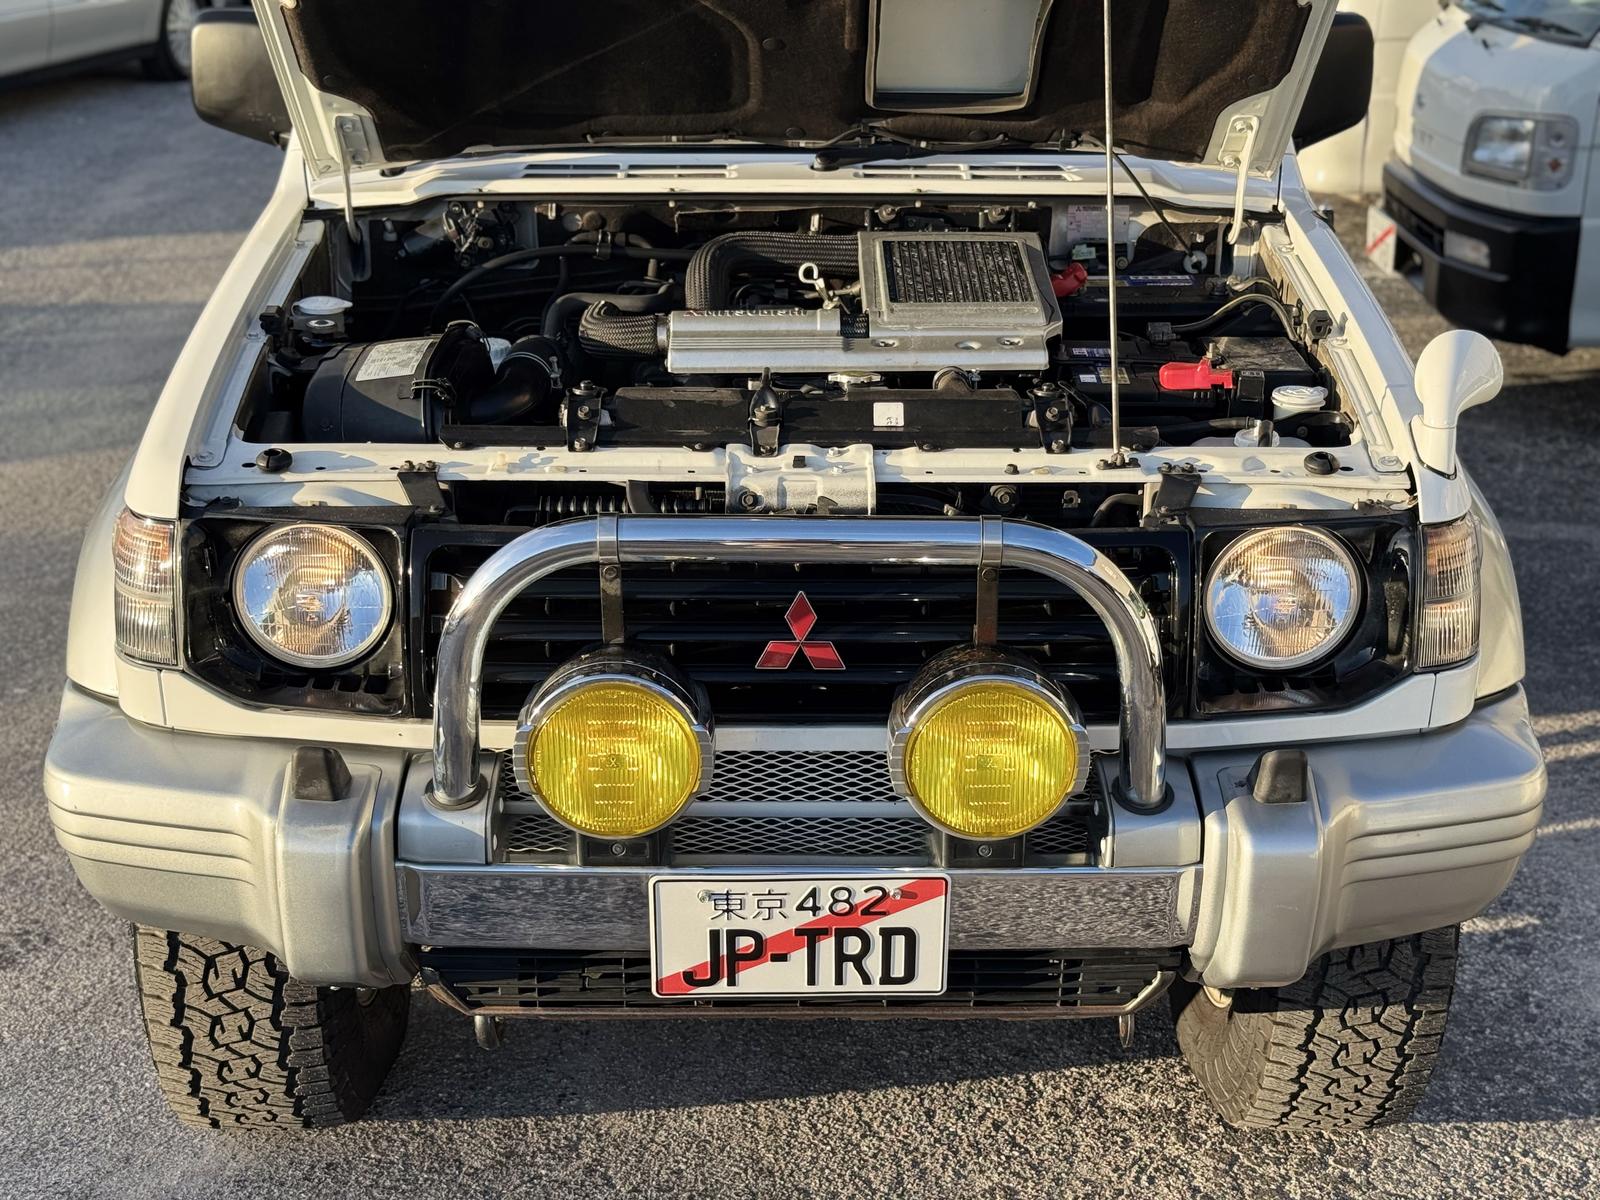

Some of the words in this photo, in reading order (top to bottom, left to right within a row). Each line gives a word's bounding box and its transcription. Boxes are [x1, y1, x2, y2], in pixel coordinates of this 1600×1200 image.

[710, 888, 788, 921] 東京
[795, 885, 890, 917] 482
[682, 926, 918, 987] JP-TRD
